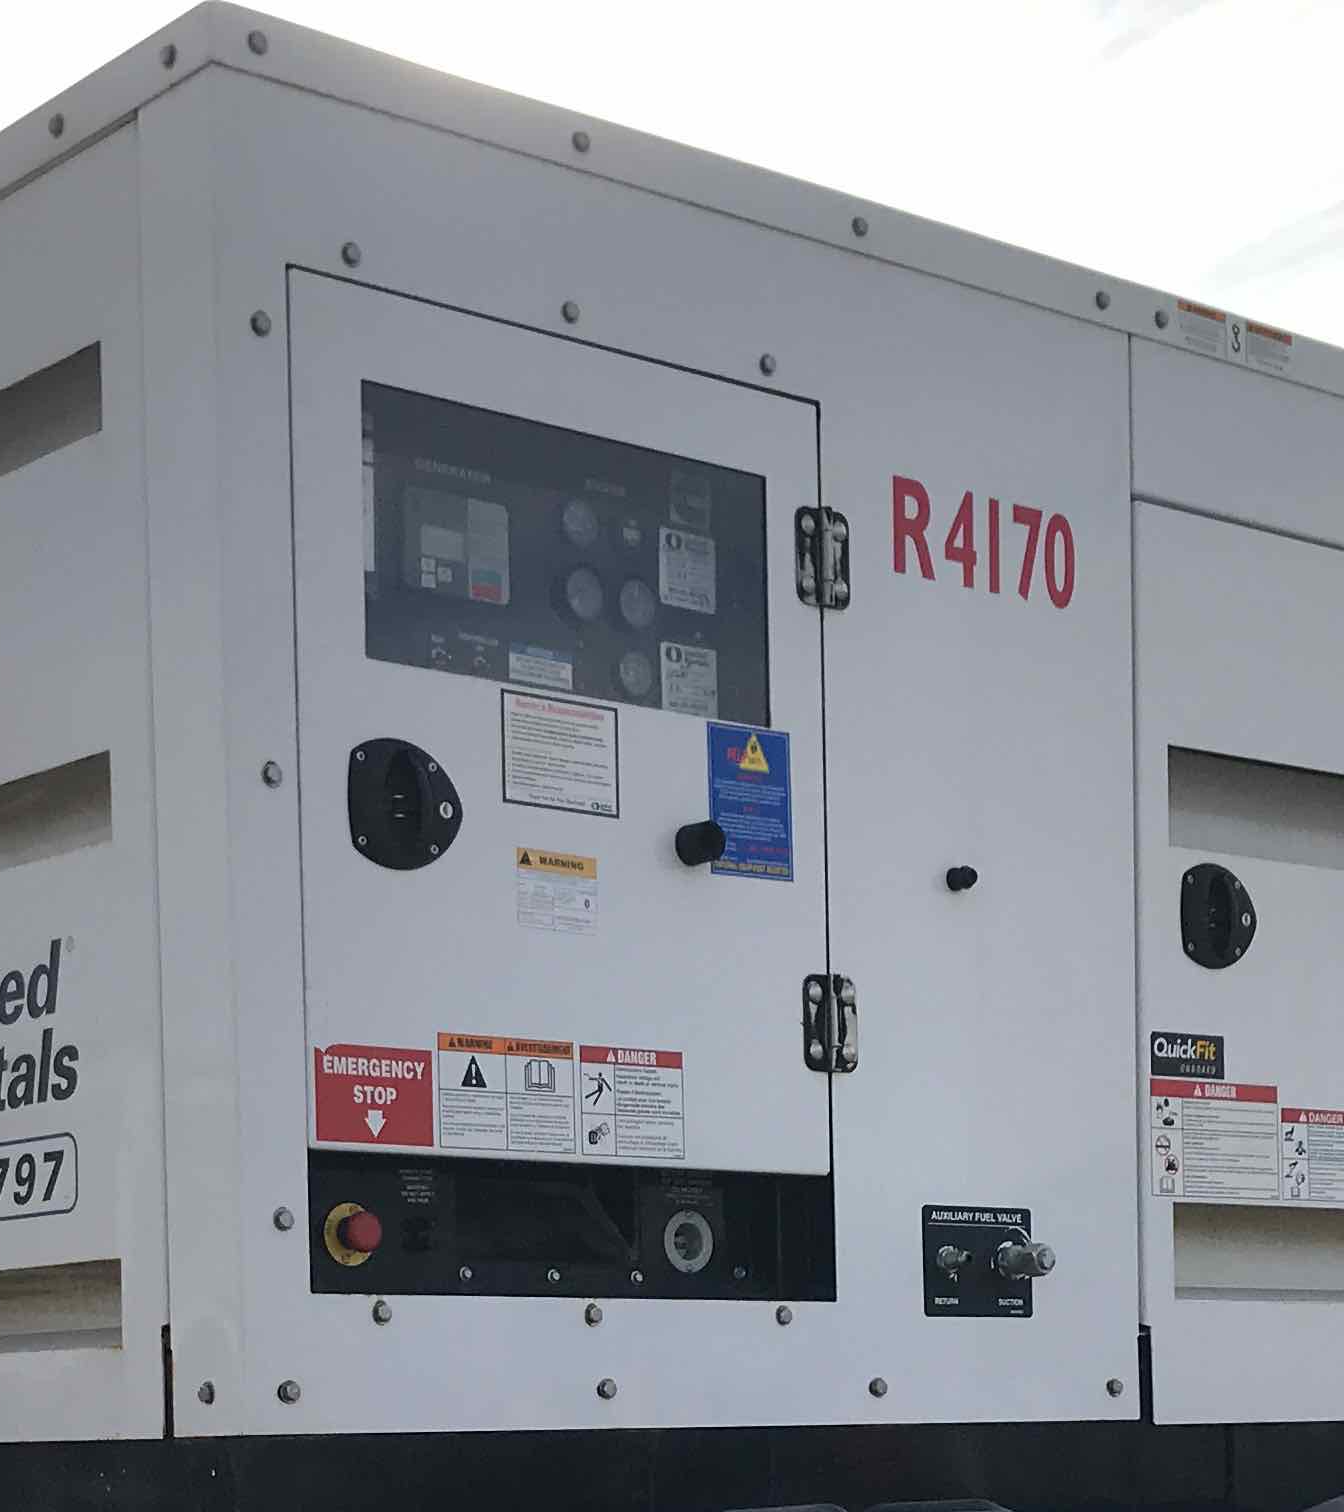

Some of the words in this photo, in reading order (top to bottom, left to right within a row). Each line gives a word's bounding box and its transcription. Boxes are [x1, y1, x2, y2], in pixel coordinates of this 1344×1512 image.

[892, 475, 1076, 609] R4170
[538, 856, 585, 870] WARNING
[1154, 1037, 1217, 1060] QuickFit
[617, 1050, 657, 1065] DANGER
[322, 1055, 425, 1080] EMERGENCY
[353, 1084, 397, 1105] STOP
[1204, 1085, 1237, 1098] DANGER
[1308, 1112, 1344, 1124] DANGER
[931, 1210, 974, 1221] AUXILIARY
[974, 1212, 996, 1222] FUEL
[997, 1213, 1022, 1224] VALVE
[998, 1298, 1024, 1306] SUCTION
